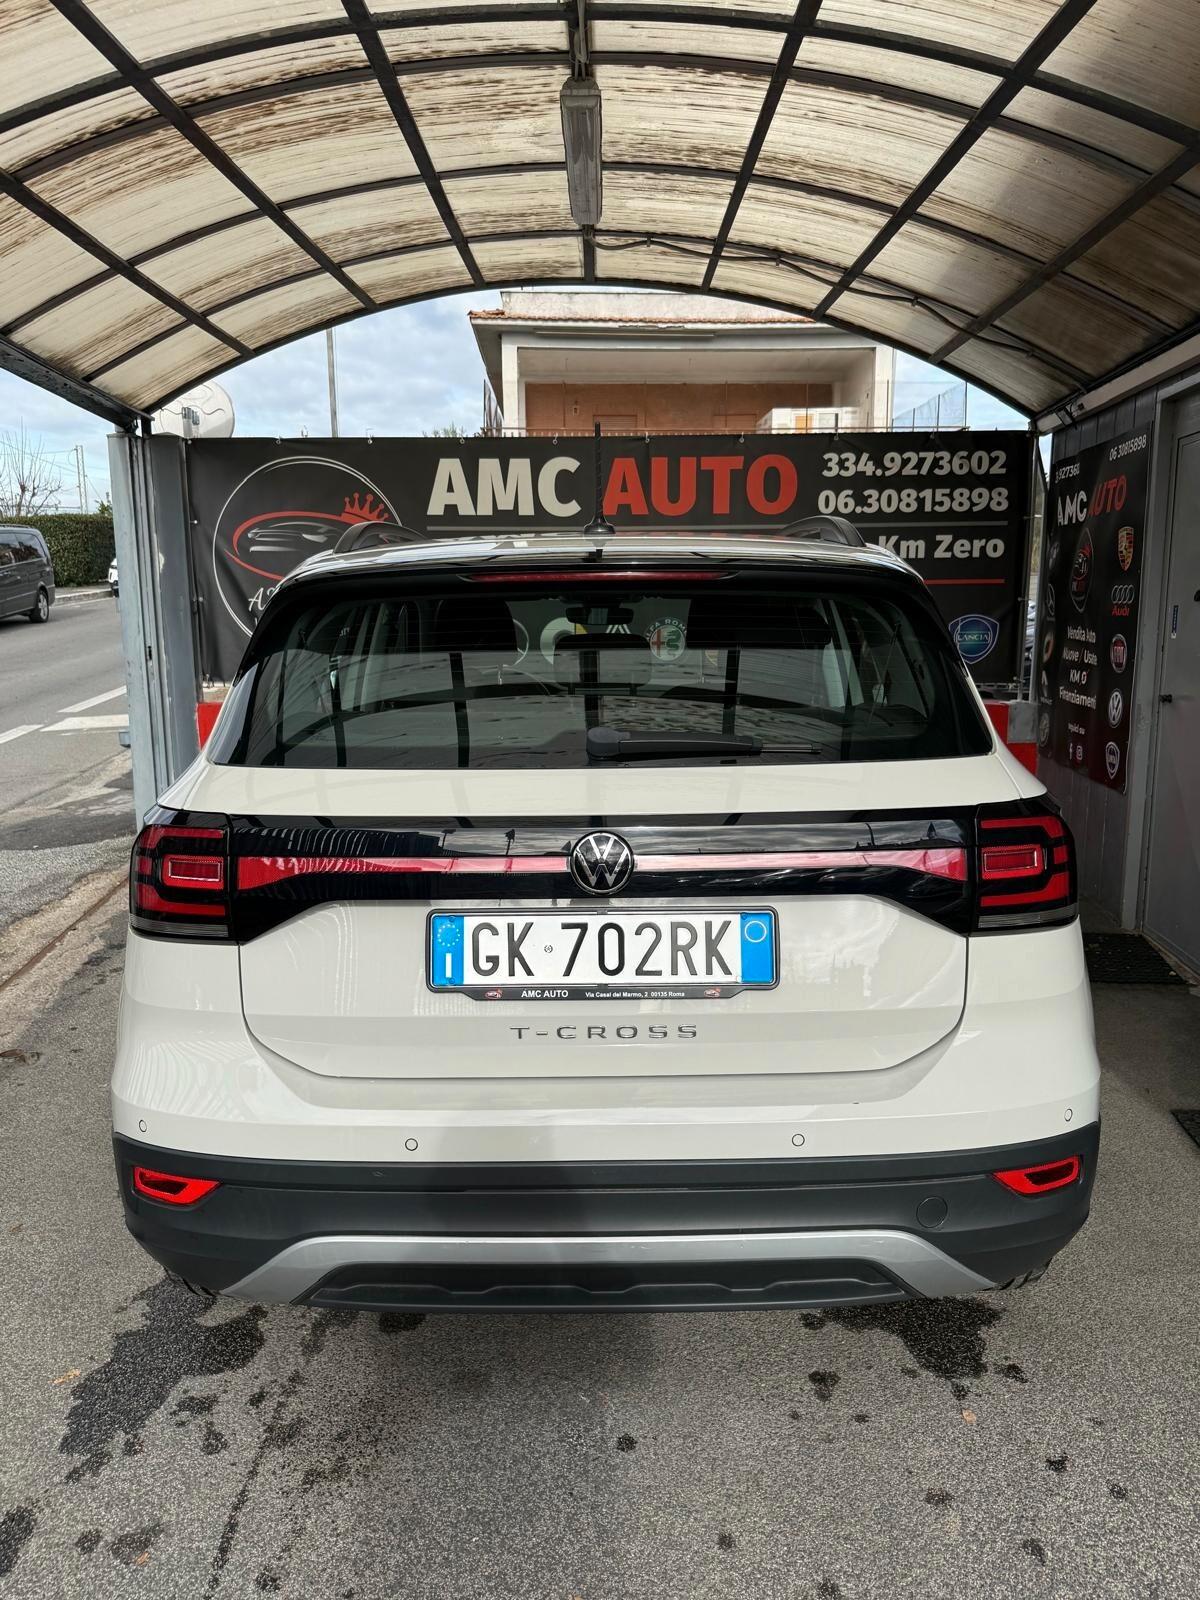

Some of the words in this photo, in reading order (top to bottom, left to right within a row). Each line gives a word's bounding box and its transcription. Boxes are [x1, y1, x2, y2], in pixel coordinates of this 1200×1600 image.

[821, 450, 1007, 478] 334.9273602
[426, 456, 582, 518] AMC
[603, 454, 799, 517] AUTO
[817, 487, 1009, 515] 06.30815898
[1057, 490, 1088, 527] AMC
[878, 535, 926, 559] Km
[933, 534, 1005, 559] Zero
[1111, 607, 1130, 617] Audi
[957, 634, 989, 642] LANCIA
[471, 921, 534, 977] GK
[560, 920, 733, 977] 702RK
[521, 989, 542, 998] AMC
[543, 989, 569, 998] AUTO
[509, 1023, 697, 1040] T-CROSS
